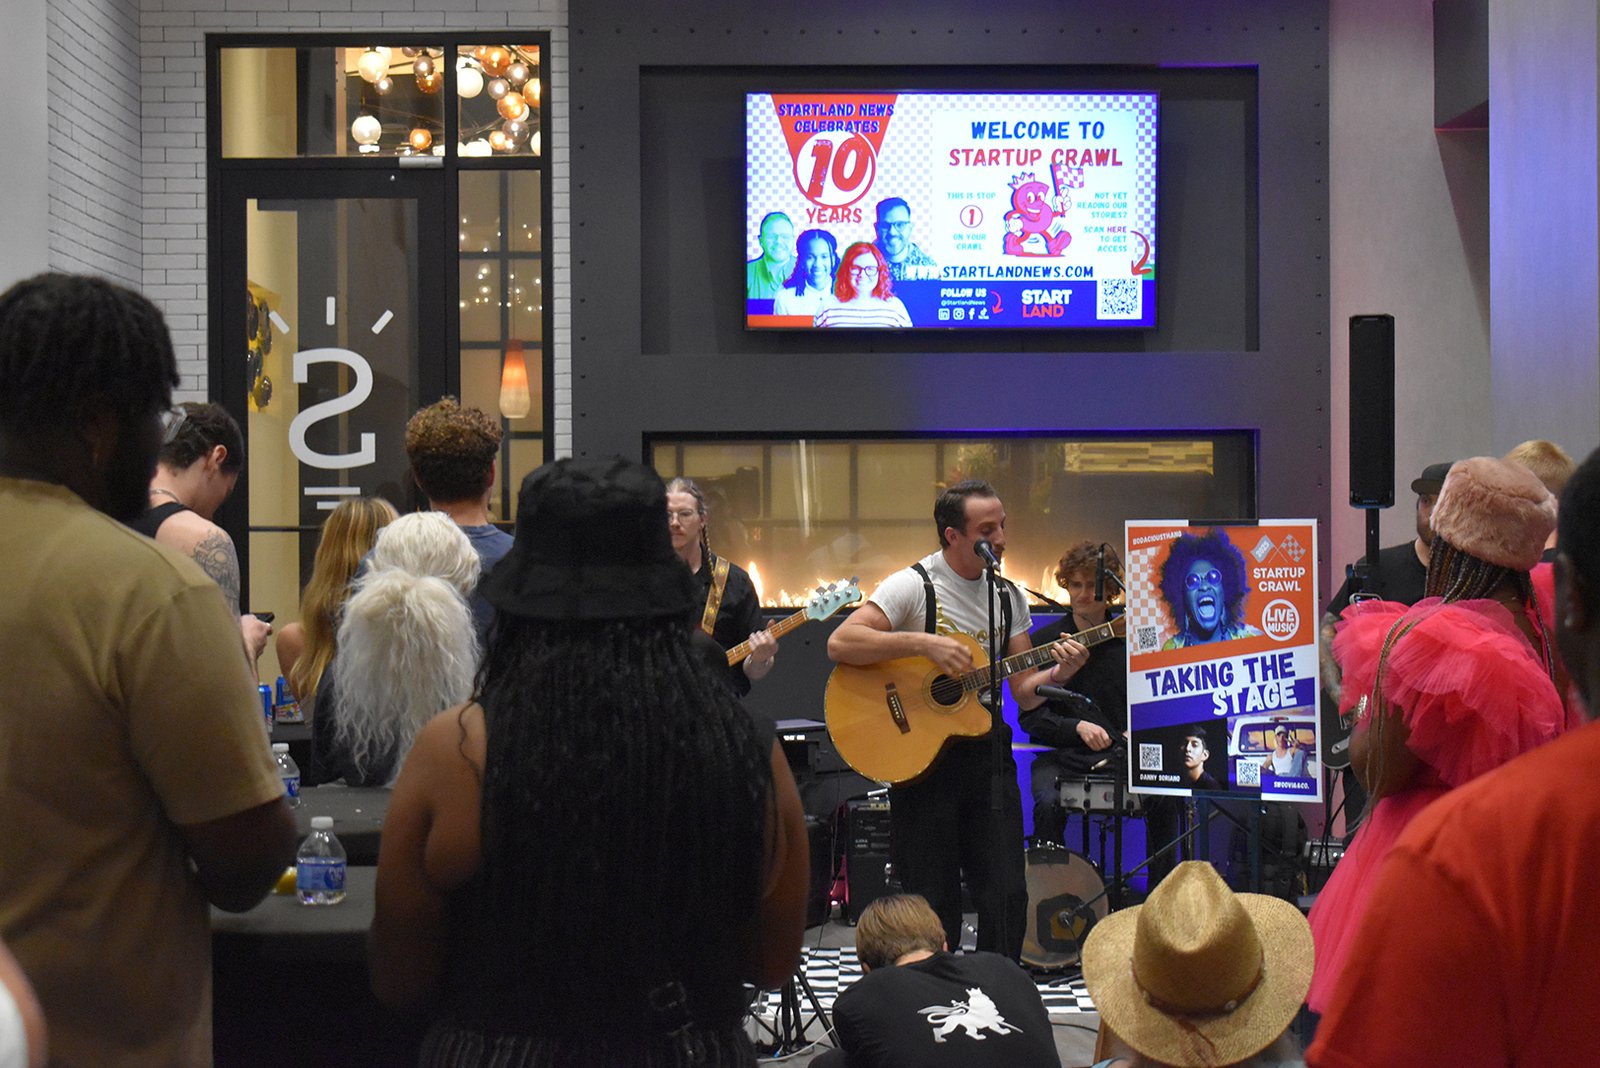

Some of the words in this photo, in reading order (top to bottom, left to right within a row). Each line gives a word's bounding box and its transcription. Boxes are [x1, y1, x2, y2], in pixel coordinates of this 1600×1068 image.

[778, 103, 854, 117] STARTLAND
[859, 103, 895, 117] NEWS
[794, 120, 880, 133] CELEBRATES
[971, 121, 1070, 139] WELCOME
[1079, 121, 1105, 139] TO
[949, 148, 1042, 167] STARTUP
[1051, 148, 1123, 167] CRAWL
[807, 137, 870, 198] 10
[947, 192, 964, 200] THIS
[966, 192, 974, 200] IS
[976, 192, 996, 200] STOP
[1094, 192, 1110, 200] NOT
[1112, 192, 1128, 200] YET
[1076, 201, 1110, 209] READING
[1112, 201, 1128, 209] OUR
[806, 207, 862, 224] YEARS
[969, 209, 975, 225] 1
[1091, 211, 1128, 219] STORIES?
[1084, 226, 1105, 234] SCAN
[1106, 226, 1127, 234] HERE
[953, 233, 964, 241] ON
[966, 233, 987, 241] YOUR
[1100, 235, 1110, 243] TO
[1112, 235, 1127, 243] GET
[956, 243, 983, 251] CRAWL
[1097, 244, 1128, 253] ACCESS
[943, 266, 1094, 278] STARTLANDNEWS.COM
[940, 288, 973, 298] FOLLOW
[975, 288, 987, 298] US
[1021, 289, 1072, 305] START
[1022, 305, 1064, 318] LAND
[1253, 567, 1305, 579] STARTUP
[1258, 581, 1301, 592] CRAWL
[1268, 608, 1294, 622] LIVE
[1268, 621, 1295, 633] MUSIC
[1145, 661, 1234, 697] TAKING
[1242, 652, 1296, 683] THE
[1212, 679, 1298, 716] STAGE
[1139, 773, 1157, 781] DANNY
